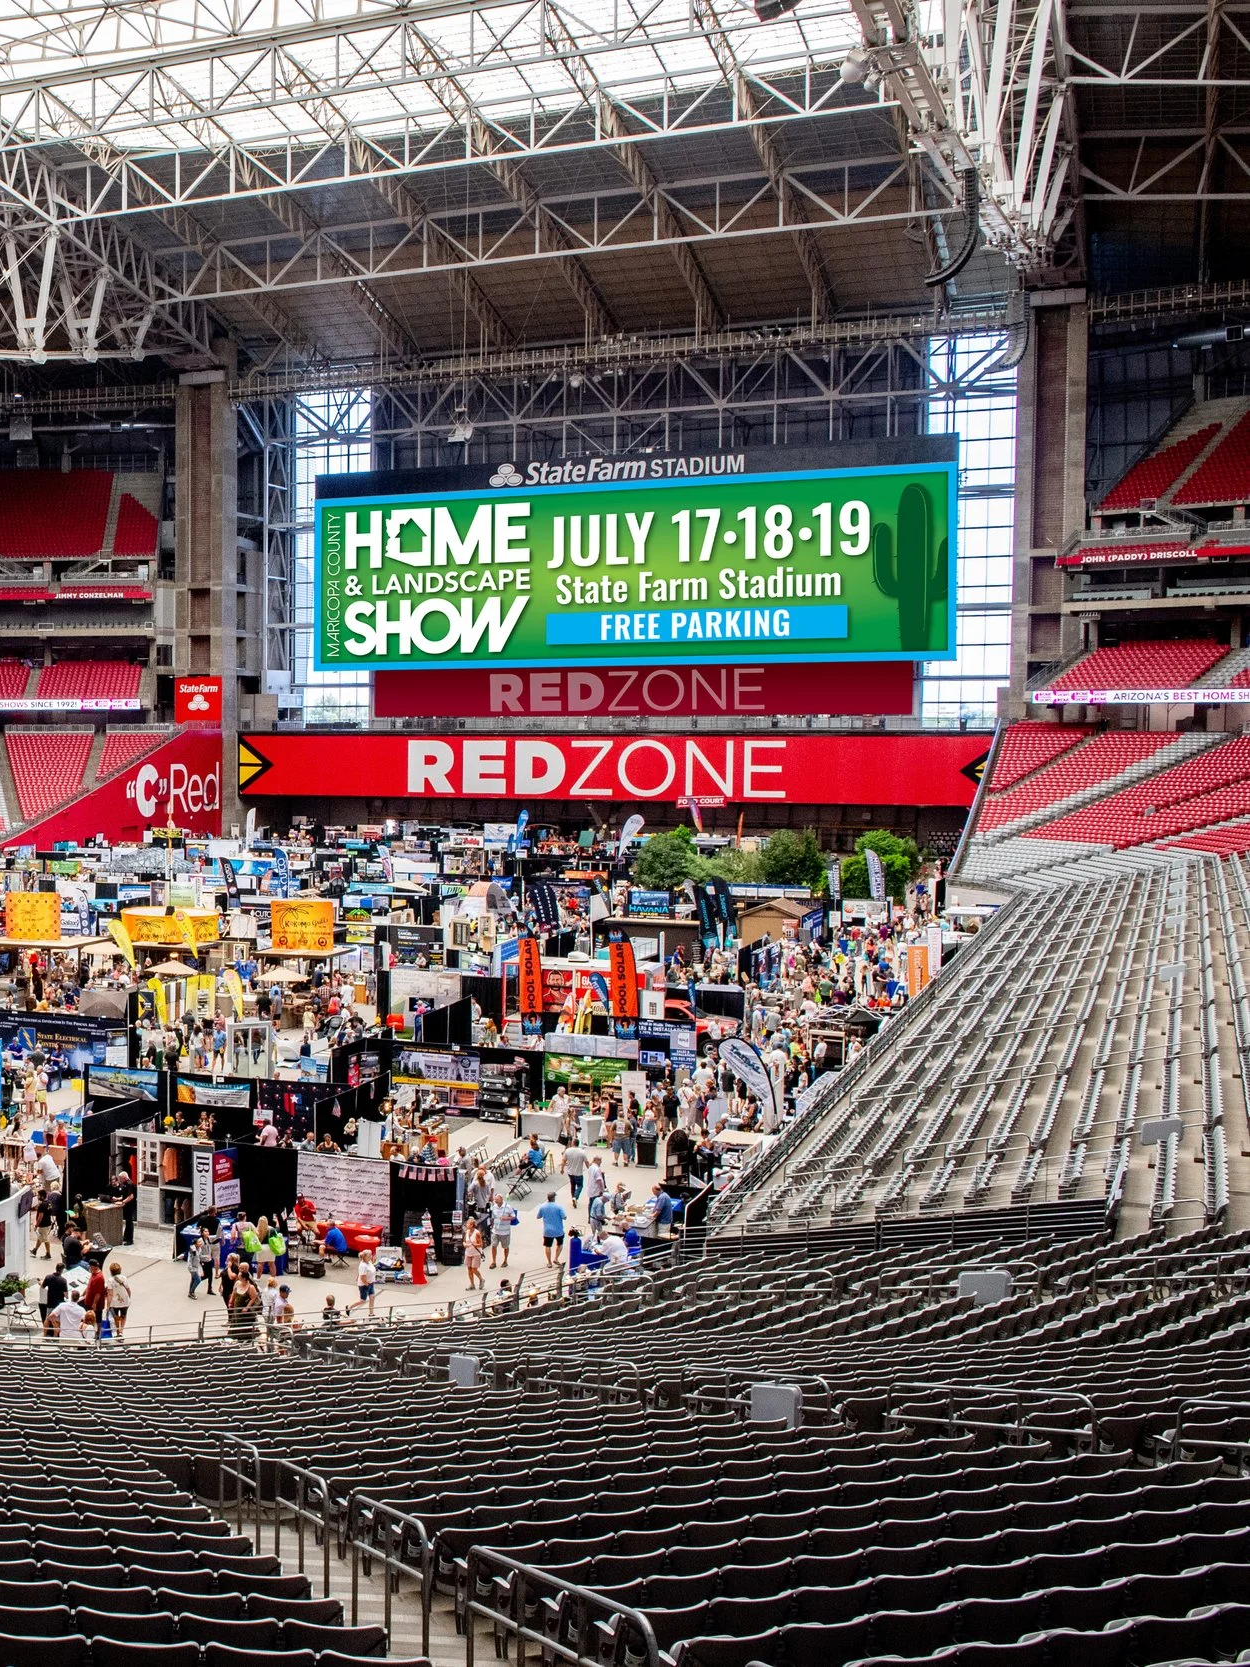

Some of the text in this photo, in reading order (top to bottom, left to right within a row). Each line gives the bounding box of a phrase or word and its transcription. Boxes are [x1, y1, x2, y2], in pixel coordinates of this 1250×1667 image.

[649, 454, 746, 479] STADIUM
[344, 502, 532, 570] HOME
[547, 511, 656, 570] JULY
[1081, 550, 1198, 564] JOHN (PADDY) DRISCOLL
[327, 514, 340, 658] MARICOPA COUNTY
[344, 568, 532, 597] & LANDSCAPE
[556, 566, 842, 604] State Farm Stadium
[344, 595, 532, 657] SHOW
[599, 608, 791, 641] FREE PARKING
[1113, 691, 1169, 701] ARIZONA'S
[1172, 691, 1198, 700] BEST
[1203, 691, 1236, 700] HOME
[169, 762, 219, 813] Red
[628, 904, 669, 913] HAVANA
[701, 899, 710, 930] FLOORING
[719, 894, 728, 918] CARPET
[60, 919, 80, 928] Galaxy
[524, 939, 536, 1009] POOL SOLAR
[615, 943, 627, 1013] POOL SOLAR
[36, 1031, 88, 1043] STATE ELECTRICAL
